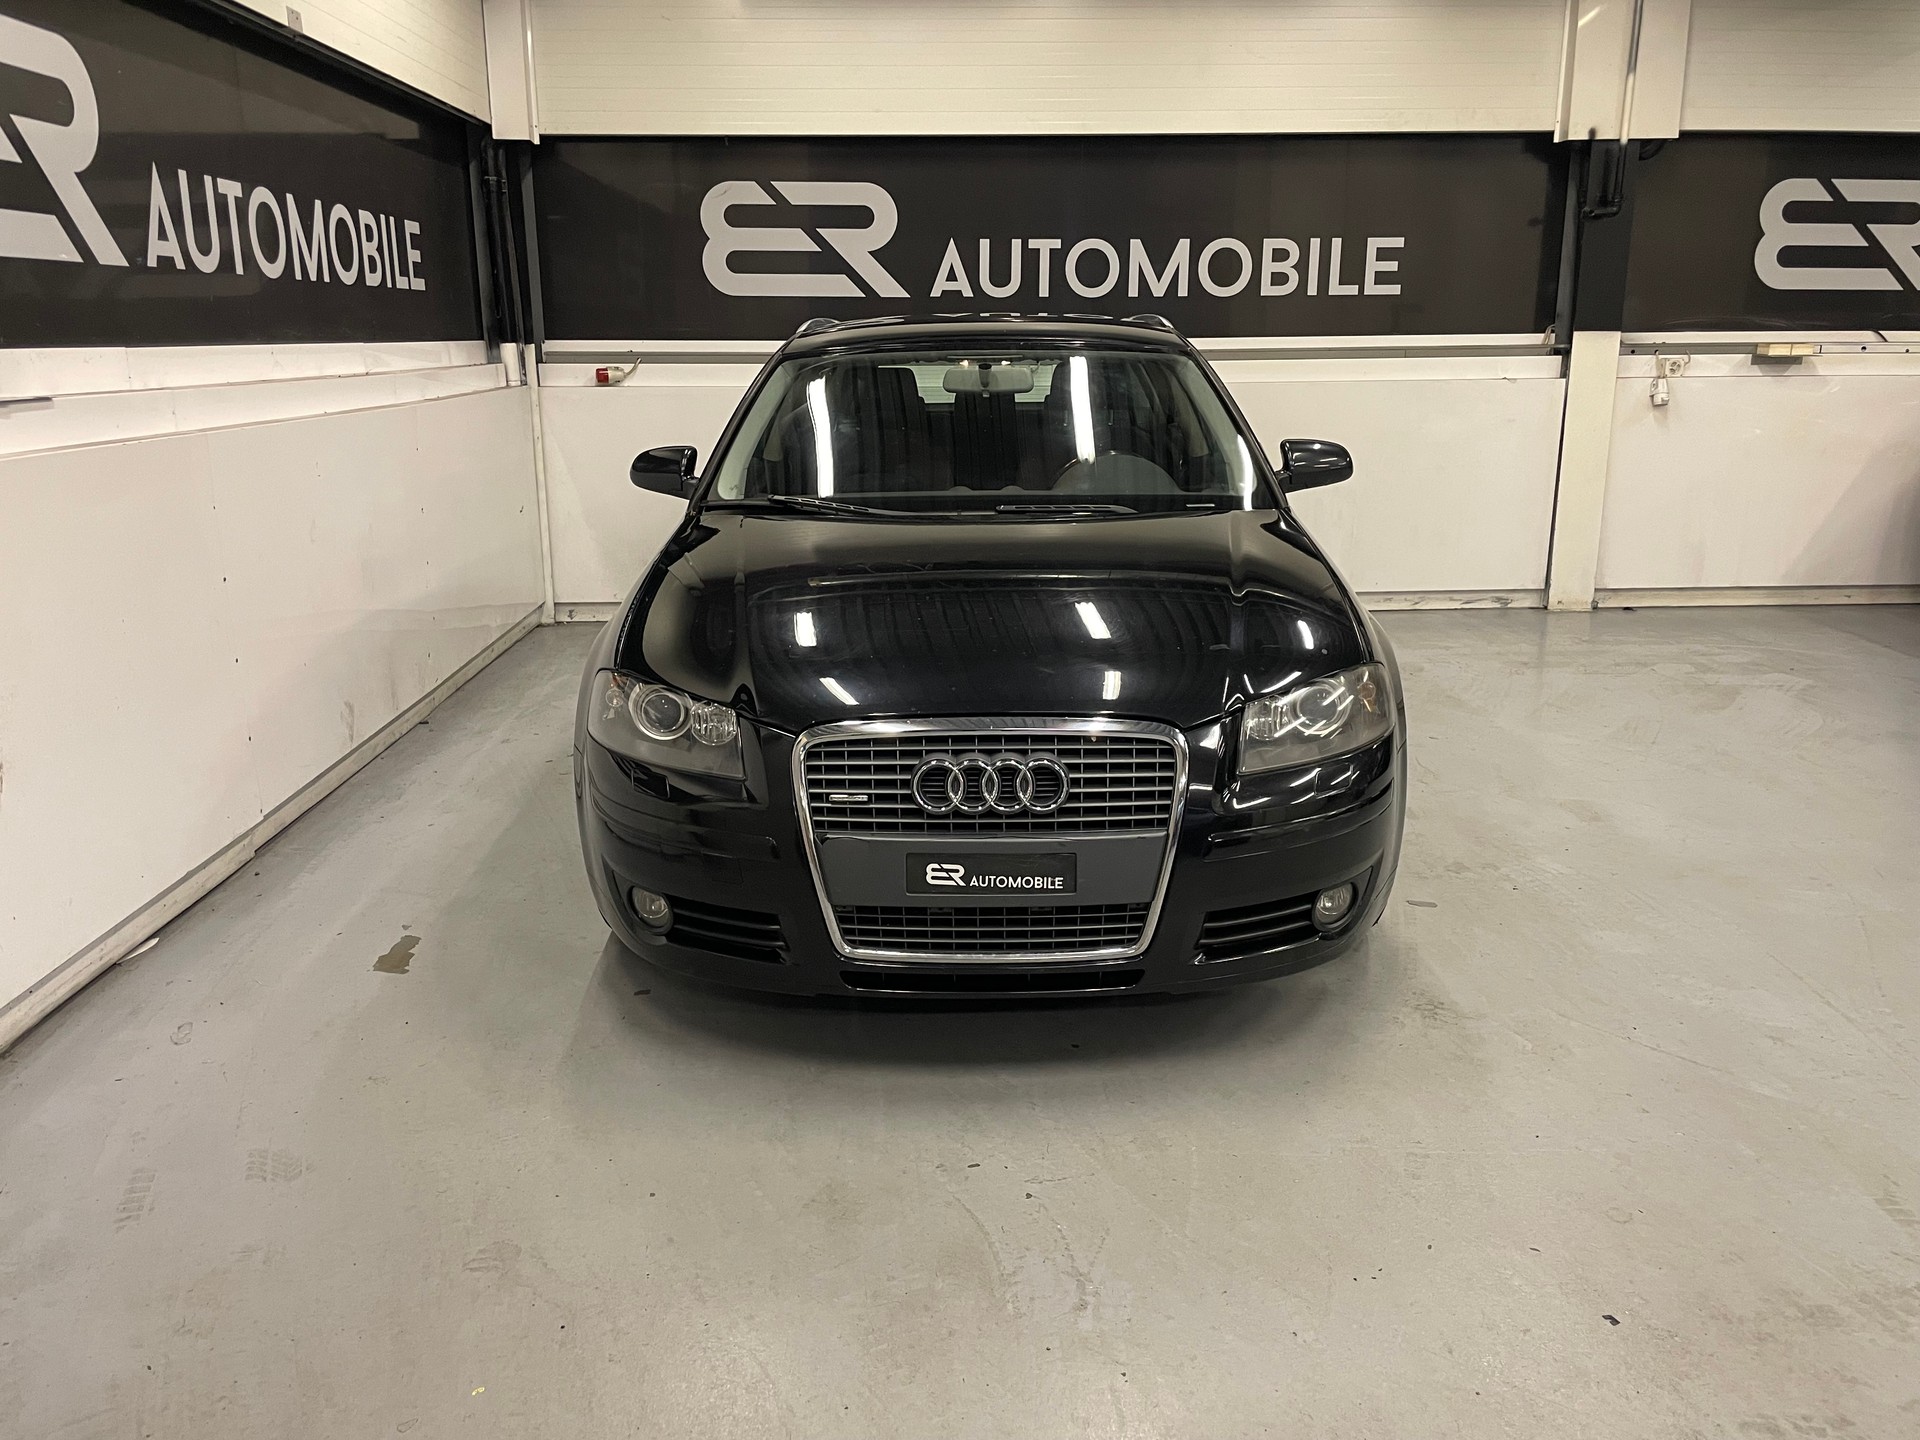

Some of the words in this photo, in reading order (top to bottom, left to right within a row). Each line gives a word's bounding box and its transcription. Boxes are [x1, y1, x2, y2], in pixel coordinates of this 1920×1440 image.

[147, 161, 426, 291] AUTOMOBILE
[700, 181, 911, 298] ER
[930, 237, 1406, 298] AUTOMOBILE
[969, 875, 1064, 889] AUTOMOBILE
